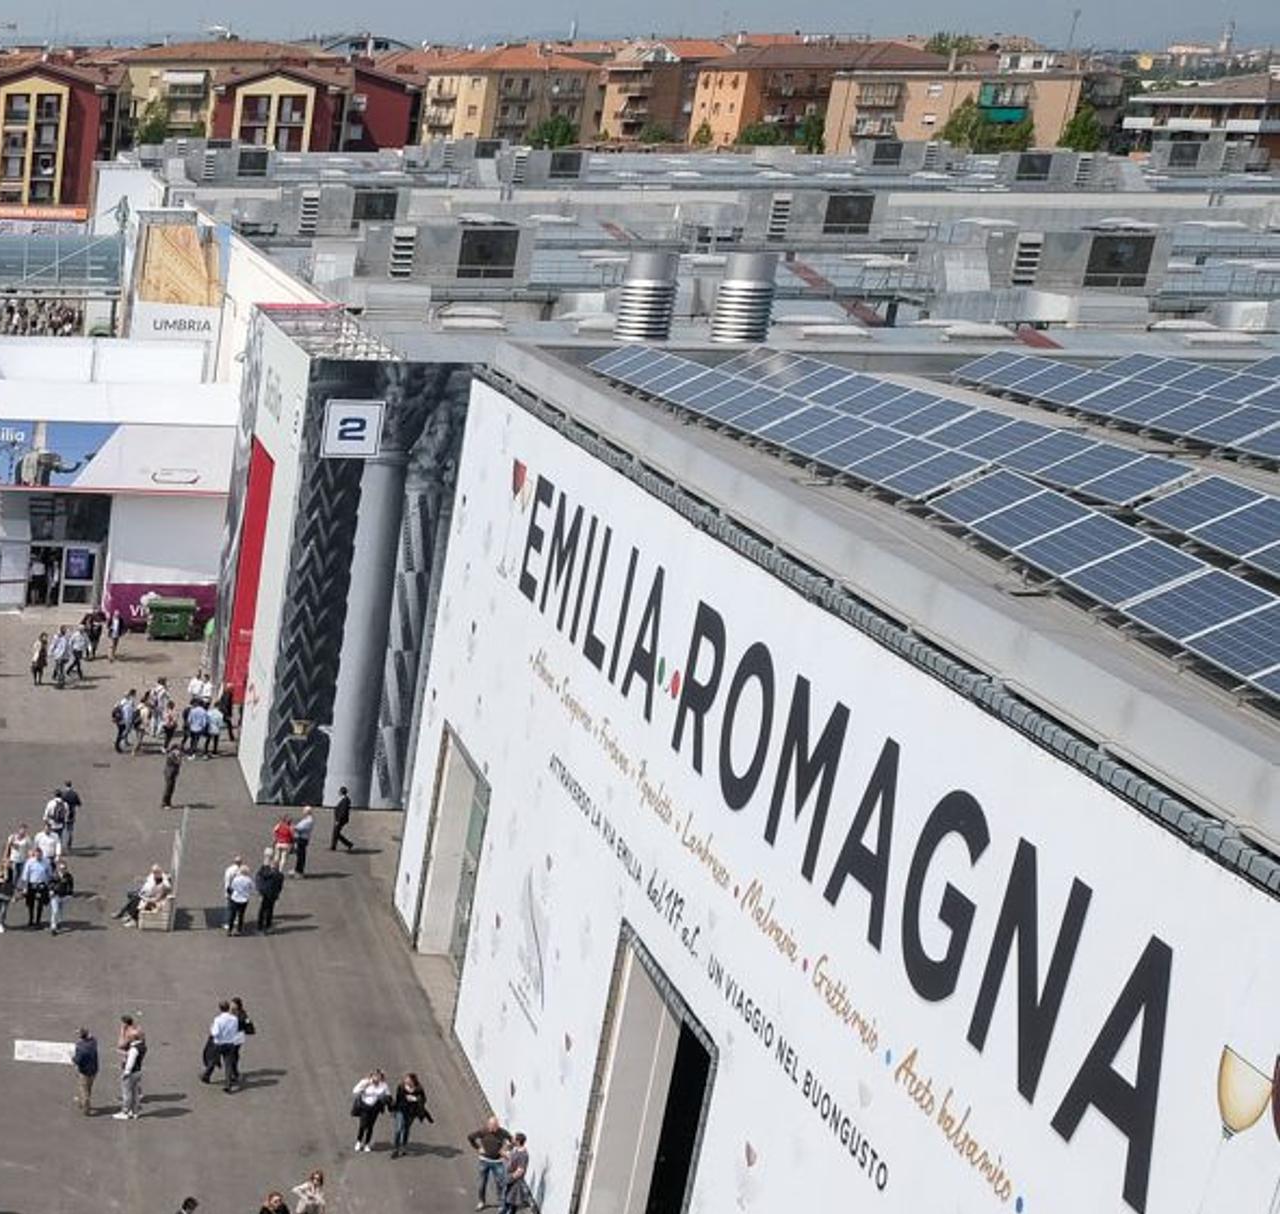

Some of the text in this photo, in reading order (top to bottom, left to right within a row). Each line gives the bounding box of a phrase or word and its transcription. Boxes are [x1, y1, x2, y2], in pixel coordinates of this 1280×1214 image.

[153, 319, 211, 331] UMBRIA
[337, 418, 366, 441] 2
[519, 473, 665, 724] EMILIA
[707, 953, 724, 991] UN
[725, 976, 775, 1048] VIAGGIO
[775, 1035, 799, 1084] NEL
[802, 1070, 889, 1192] BUONGUSTO
[936, 1087, 1013, 1202] balsamico
